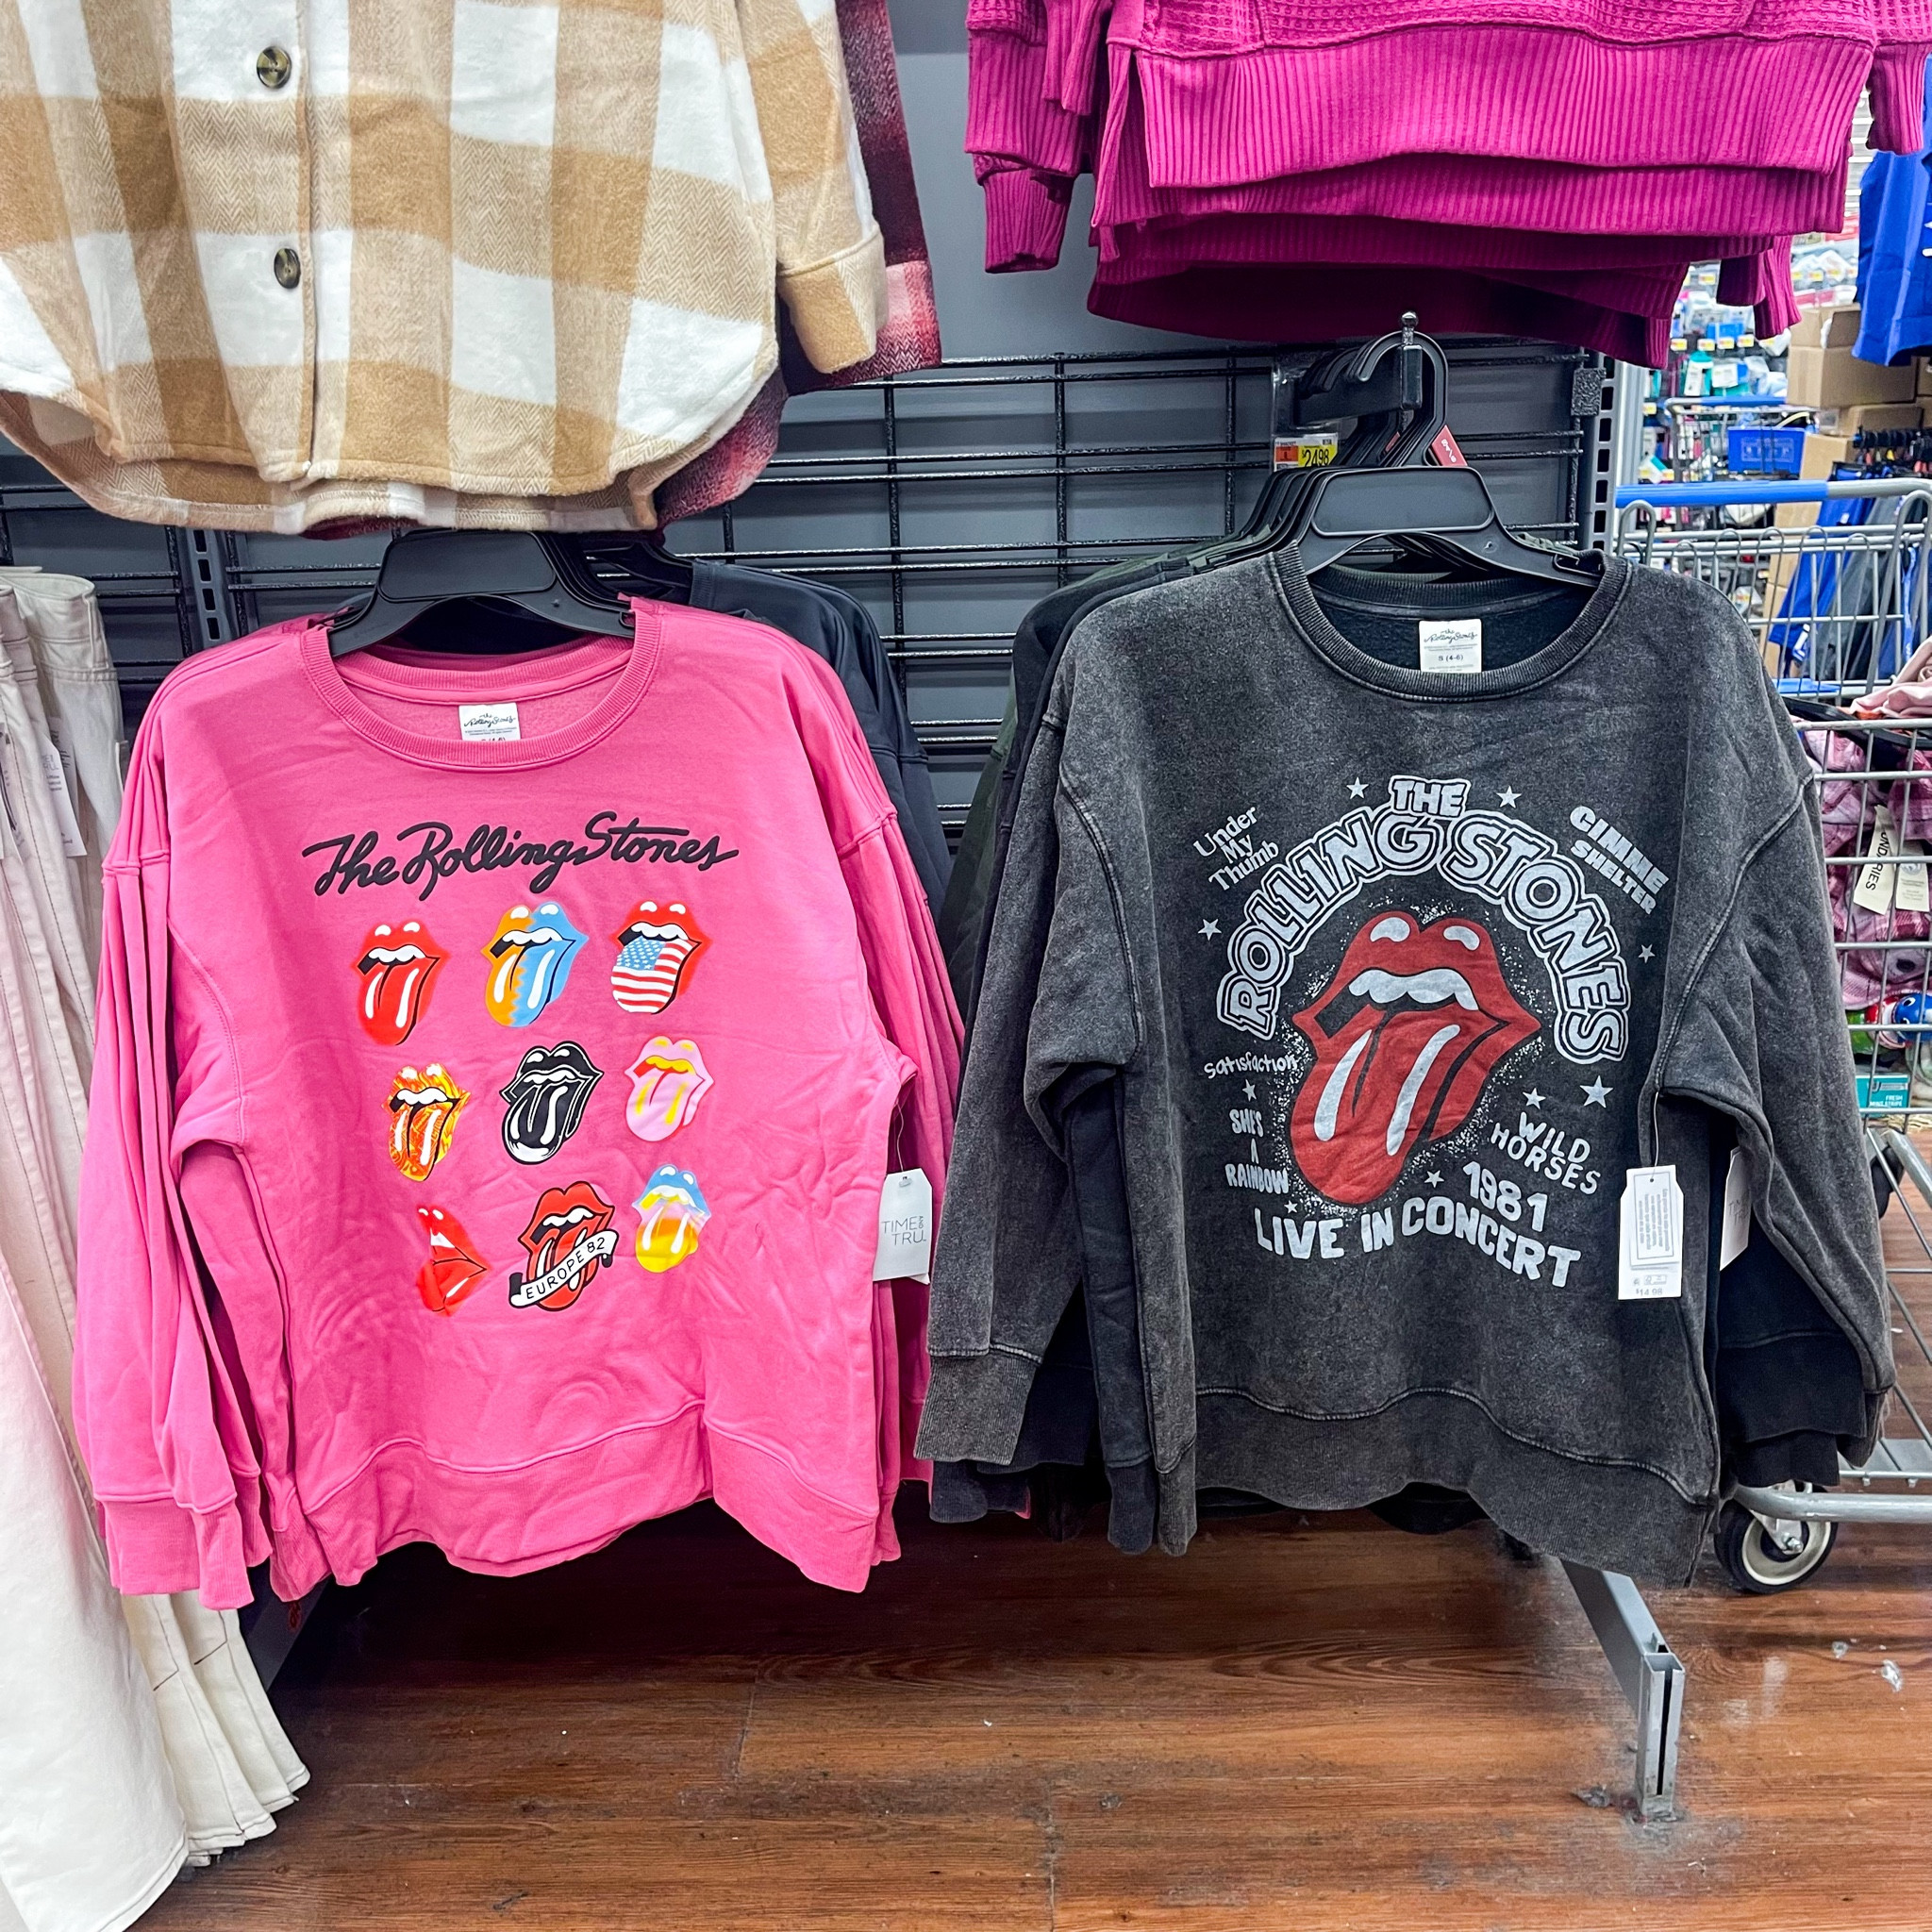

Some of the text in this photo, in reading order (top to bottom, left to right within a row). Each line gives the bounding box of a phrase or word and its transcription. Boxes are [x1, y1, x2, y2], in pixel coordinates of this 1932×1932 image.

[1391, 777, 1469, 817] THE
[302, 811, 740, 902] The Rolling Stones
[1192, 807, 1257, 857] Under
[1221, 834, 1254, 864] My
[1208, 840, 1279, 891] Thumb
[1570, 840, 1657, 915] SHELTER
[1220, 808, 1628, 1061] ROLLING STONES
[1250, 1138, 1259, 1164] A
[1491, 1122, 1602, 1195] HORSES
[1519, 1111, 1591, 1163] WILD
[1224, 1163, 1290, 1194] RAINBOW
[1462, 1161, 1548, 1232] 1981
[881, 1216, 918, 1234] TIME
[891, 1230, 924, 1246] TRU
[1254, 1208, 1345, 1259] LIVE
[1360, 1207, 1394, 1253] IN
[1401, 1196, 1582, 1288] CONCERT
[525, 1237, 606, 1300] EUROPE 82
